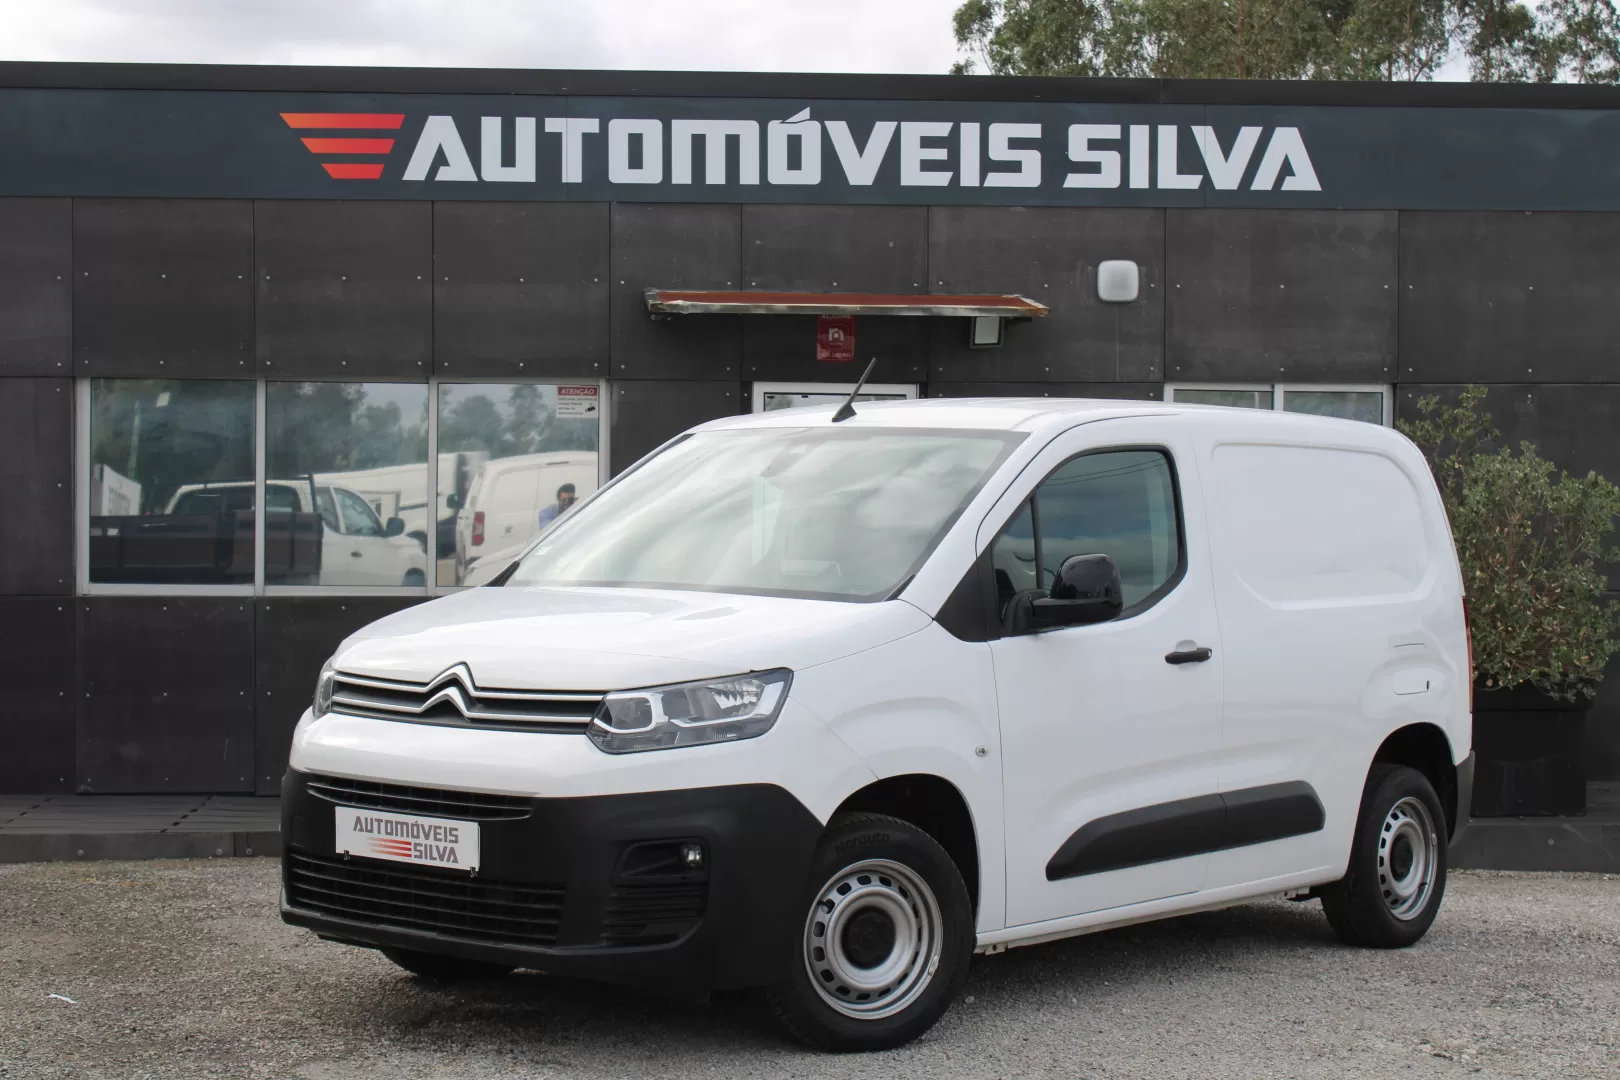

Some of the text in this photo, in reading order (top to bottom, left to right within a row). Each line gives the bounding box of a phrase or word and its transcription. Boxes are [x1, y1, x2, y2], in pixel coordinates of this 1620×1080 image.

[402, 107, 1322, 191] AUTOMÓVEIS SILVA
[560, 387, 595, 396] ATENÇÃO
[353, 816, 459, 843] AUTOMÓVEIS
[413, 842, 459, 864] SILVA
